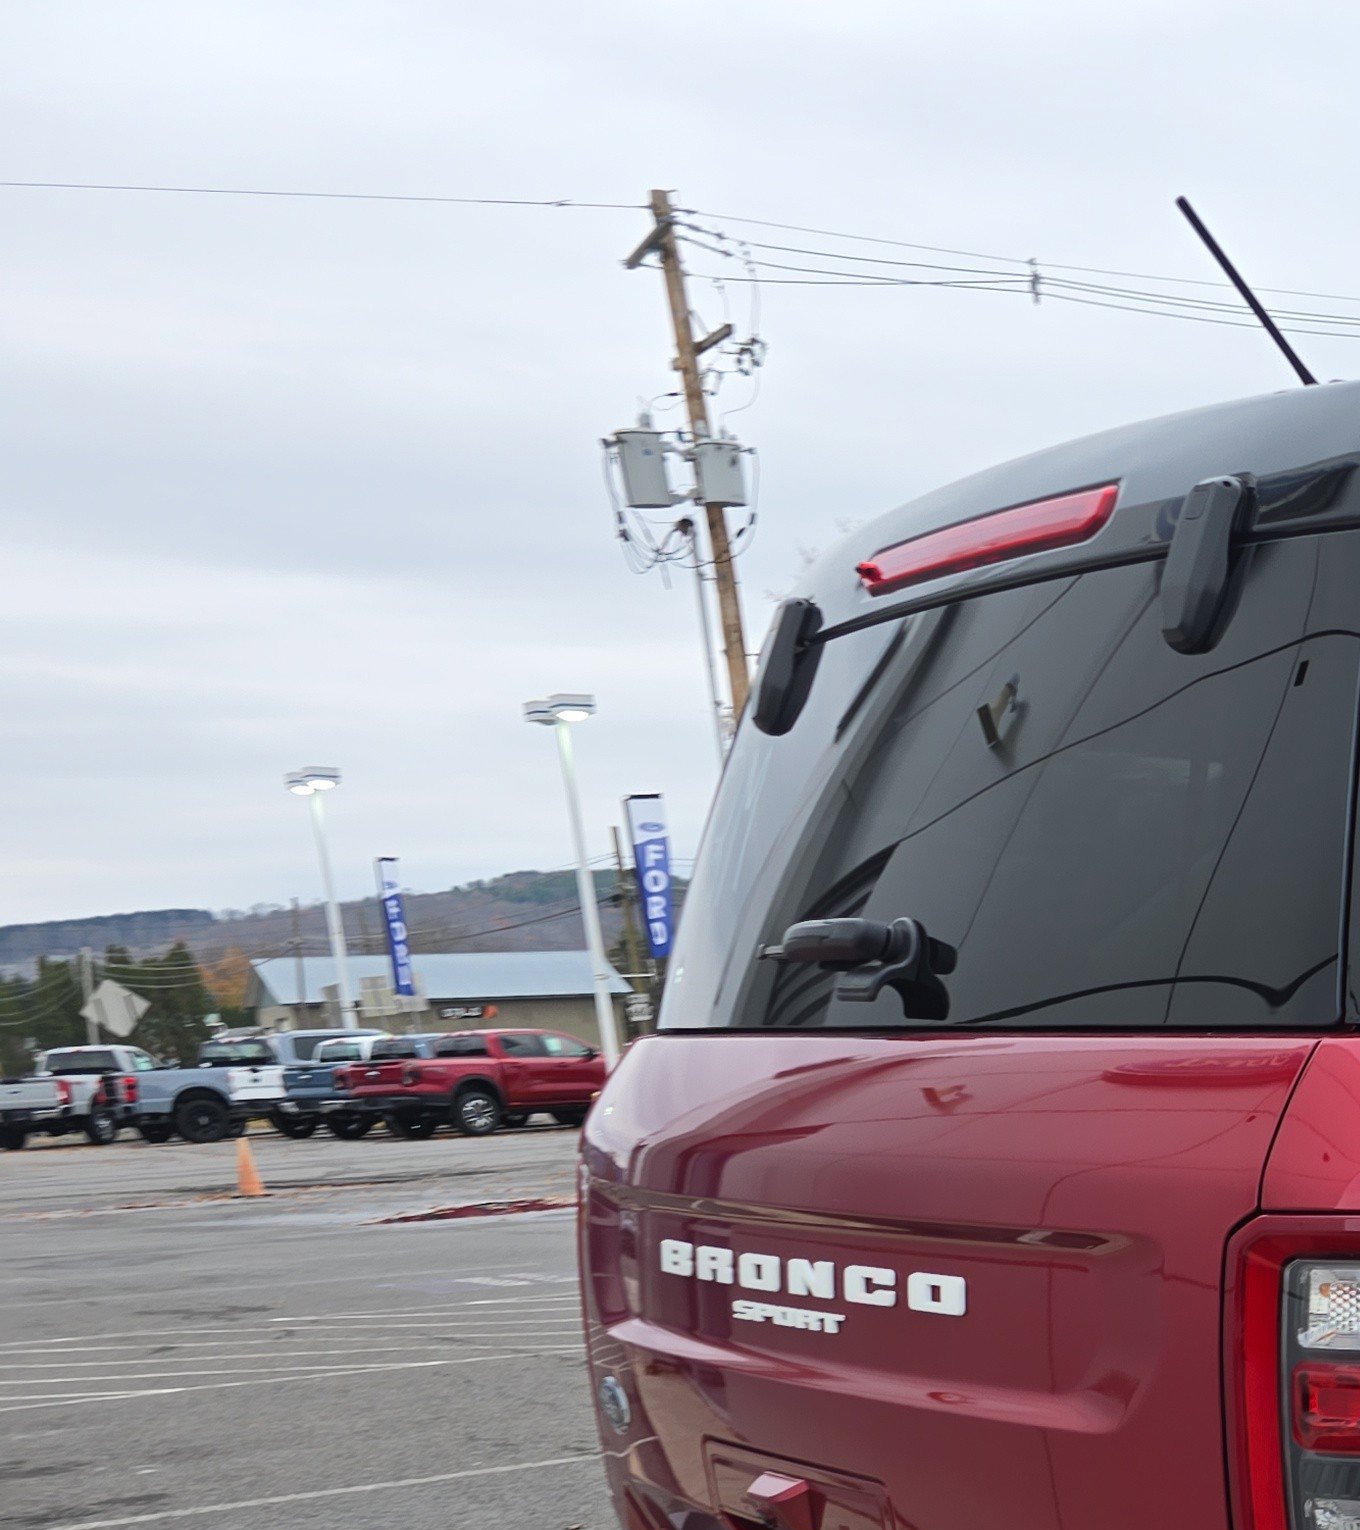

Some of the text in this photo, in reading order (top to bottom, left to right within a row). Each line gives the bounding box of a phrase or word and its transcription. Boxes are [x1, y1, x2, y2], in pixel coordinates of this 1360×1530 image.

[643, 844, 669, 946] FORD
[659, 1238, 968, 1317] BRONCO
[731, 1299, 846, 1334] SPORT
